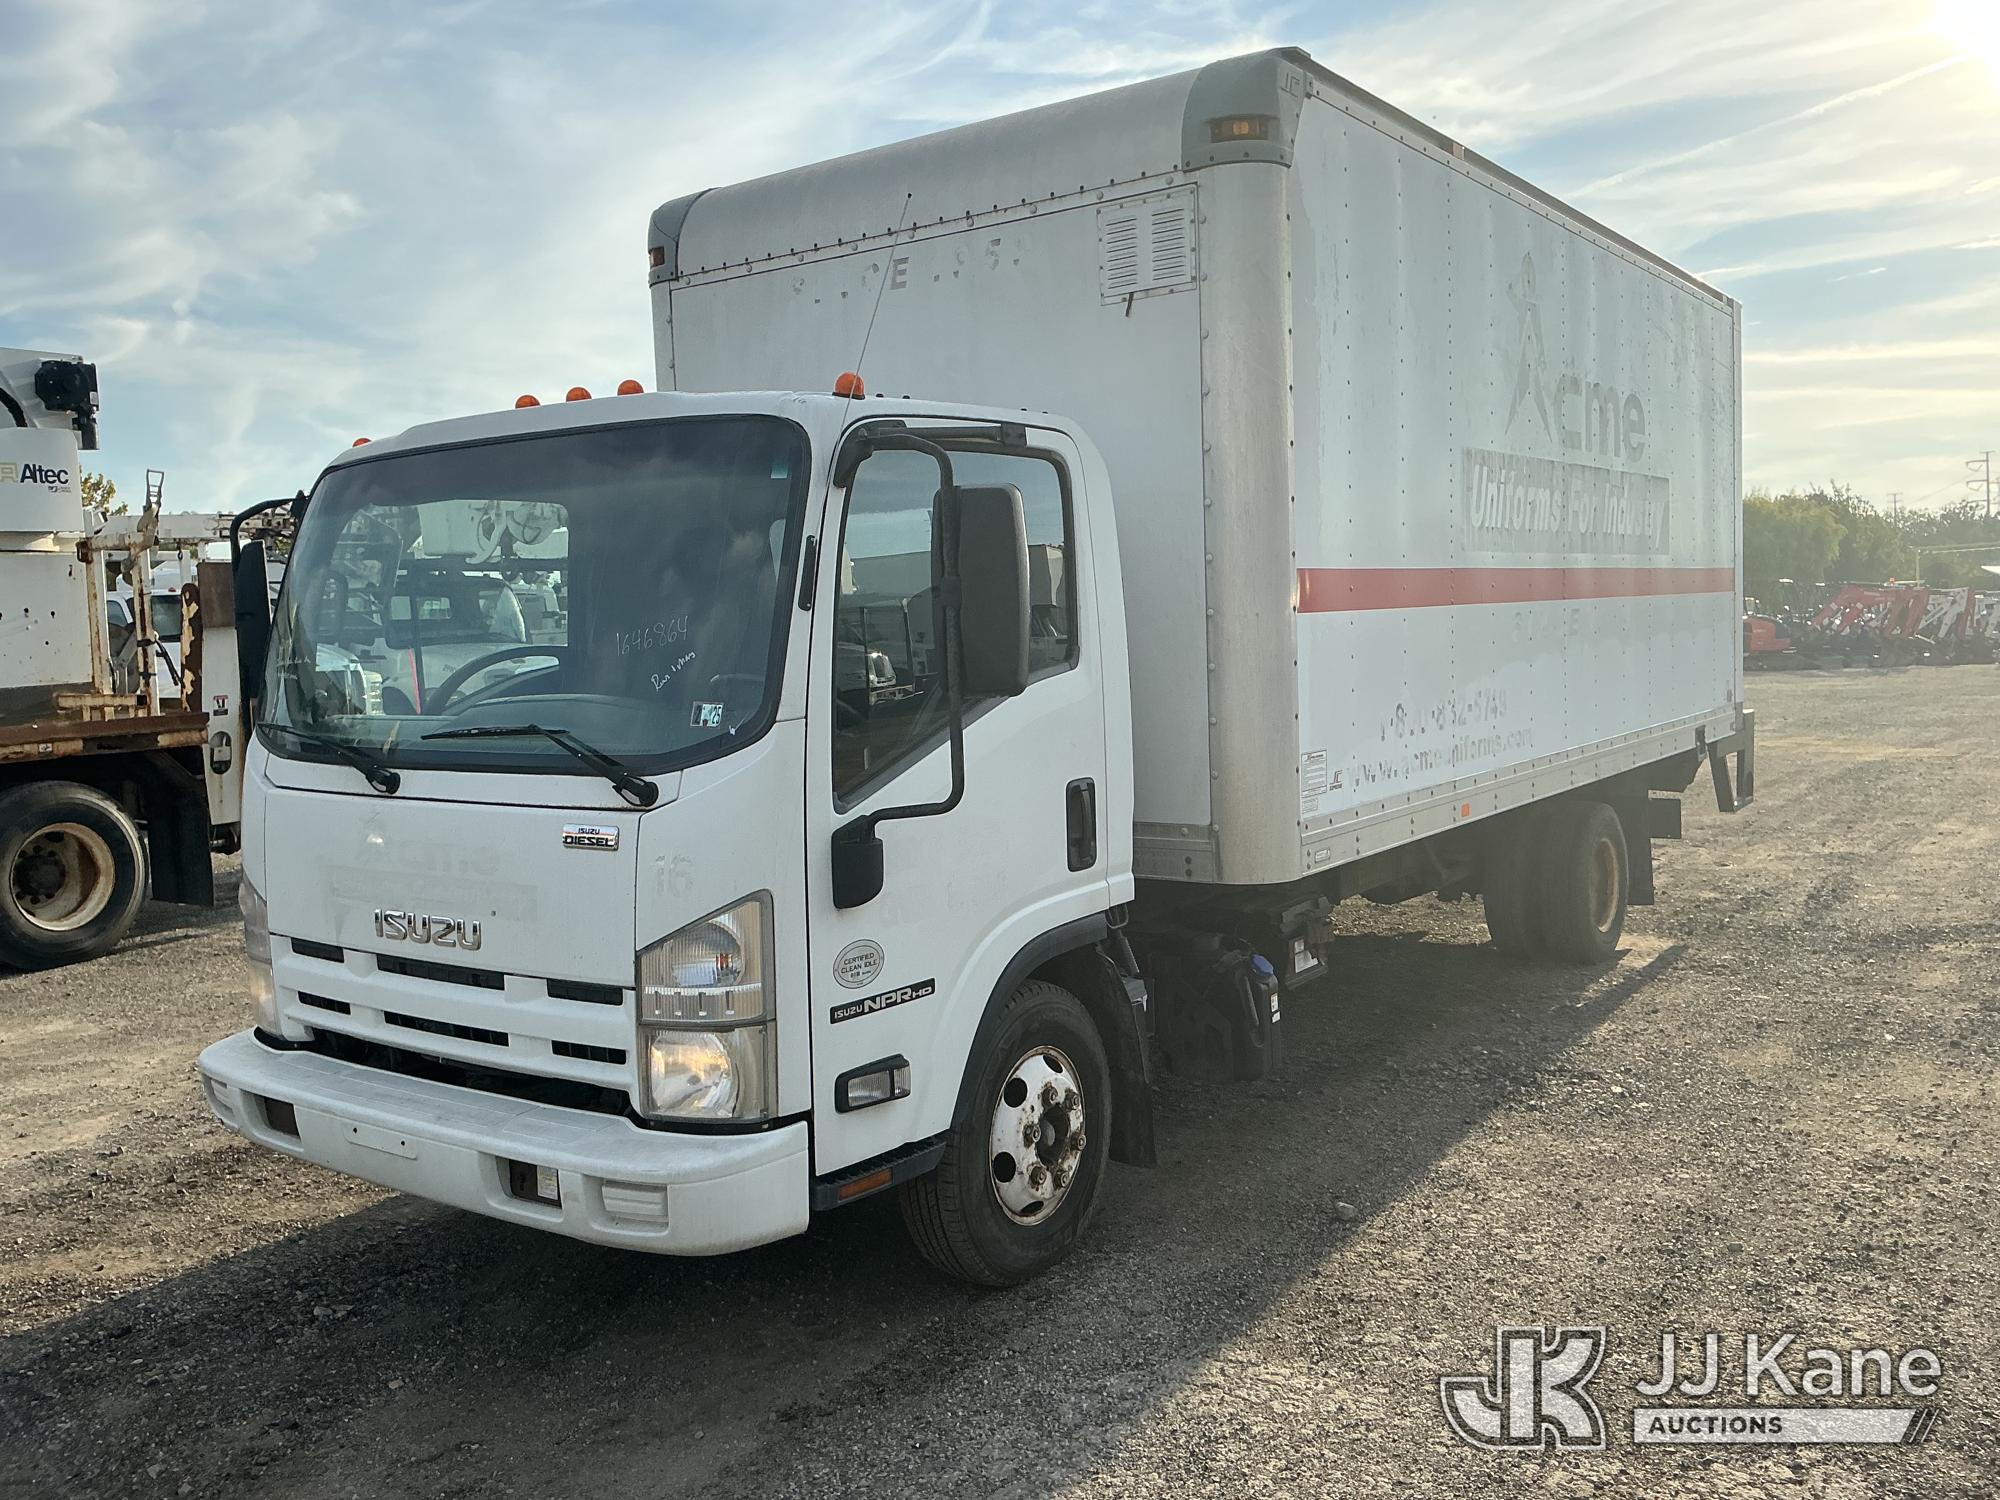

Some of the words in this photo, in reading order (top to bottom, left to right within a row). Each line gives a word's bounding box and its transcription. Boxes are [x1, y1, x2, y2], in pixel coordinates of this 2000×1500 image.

[20, 464, 69, 484] Altec
[1471, 464, 1563, 534] Uniforms
[1567, 478, 1599, 535] For
[616, 615, 688, 657] 1646864
[578, 827, 600, 835] ISUZU
[563, 835, 614, 848] DIESEL
[374, 908, 482, 950] ISUZU
[841, 963, 862, 975] CLEAN
[863, 959, 878, 970] IDLE
[844, 953, 875, 966] CERTIFIED
[834, 1005, 863, 1019] ISUZU
[864, 988, 912, 1012] NPR
[912, 985, 933, 999] HD
